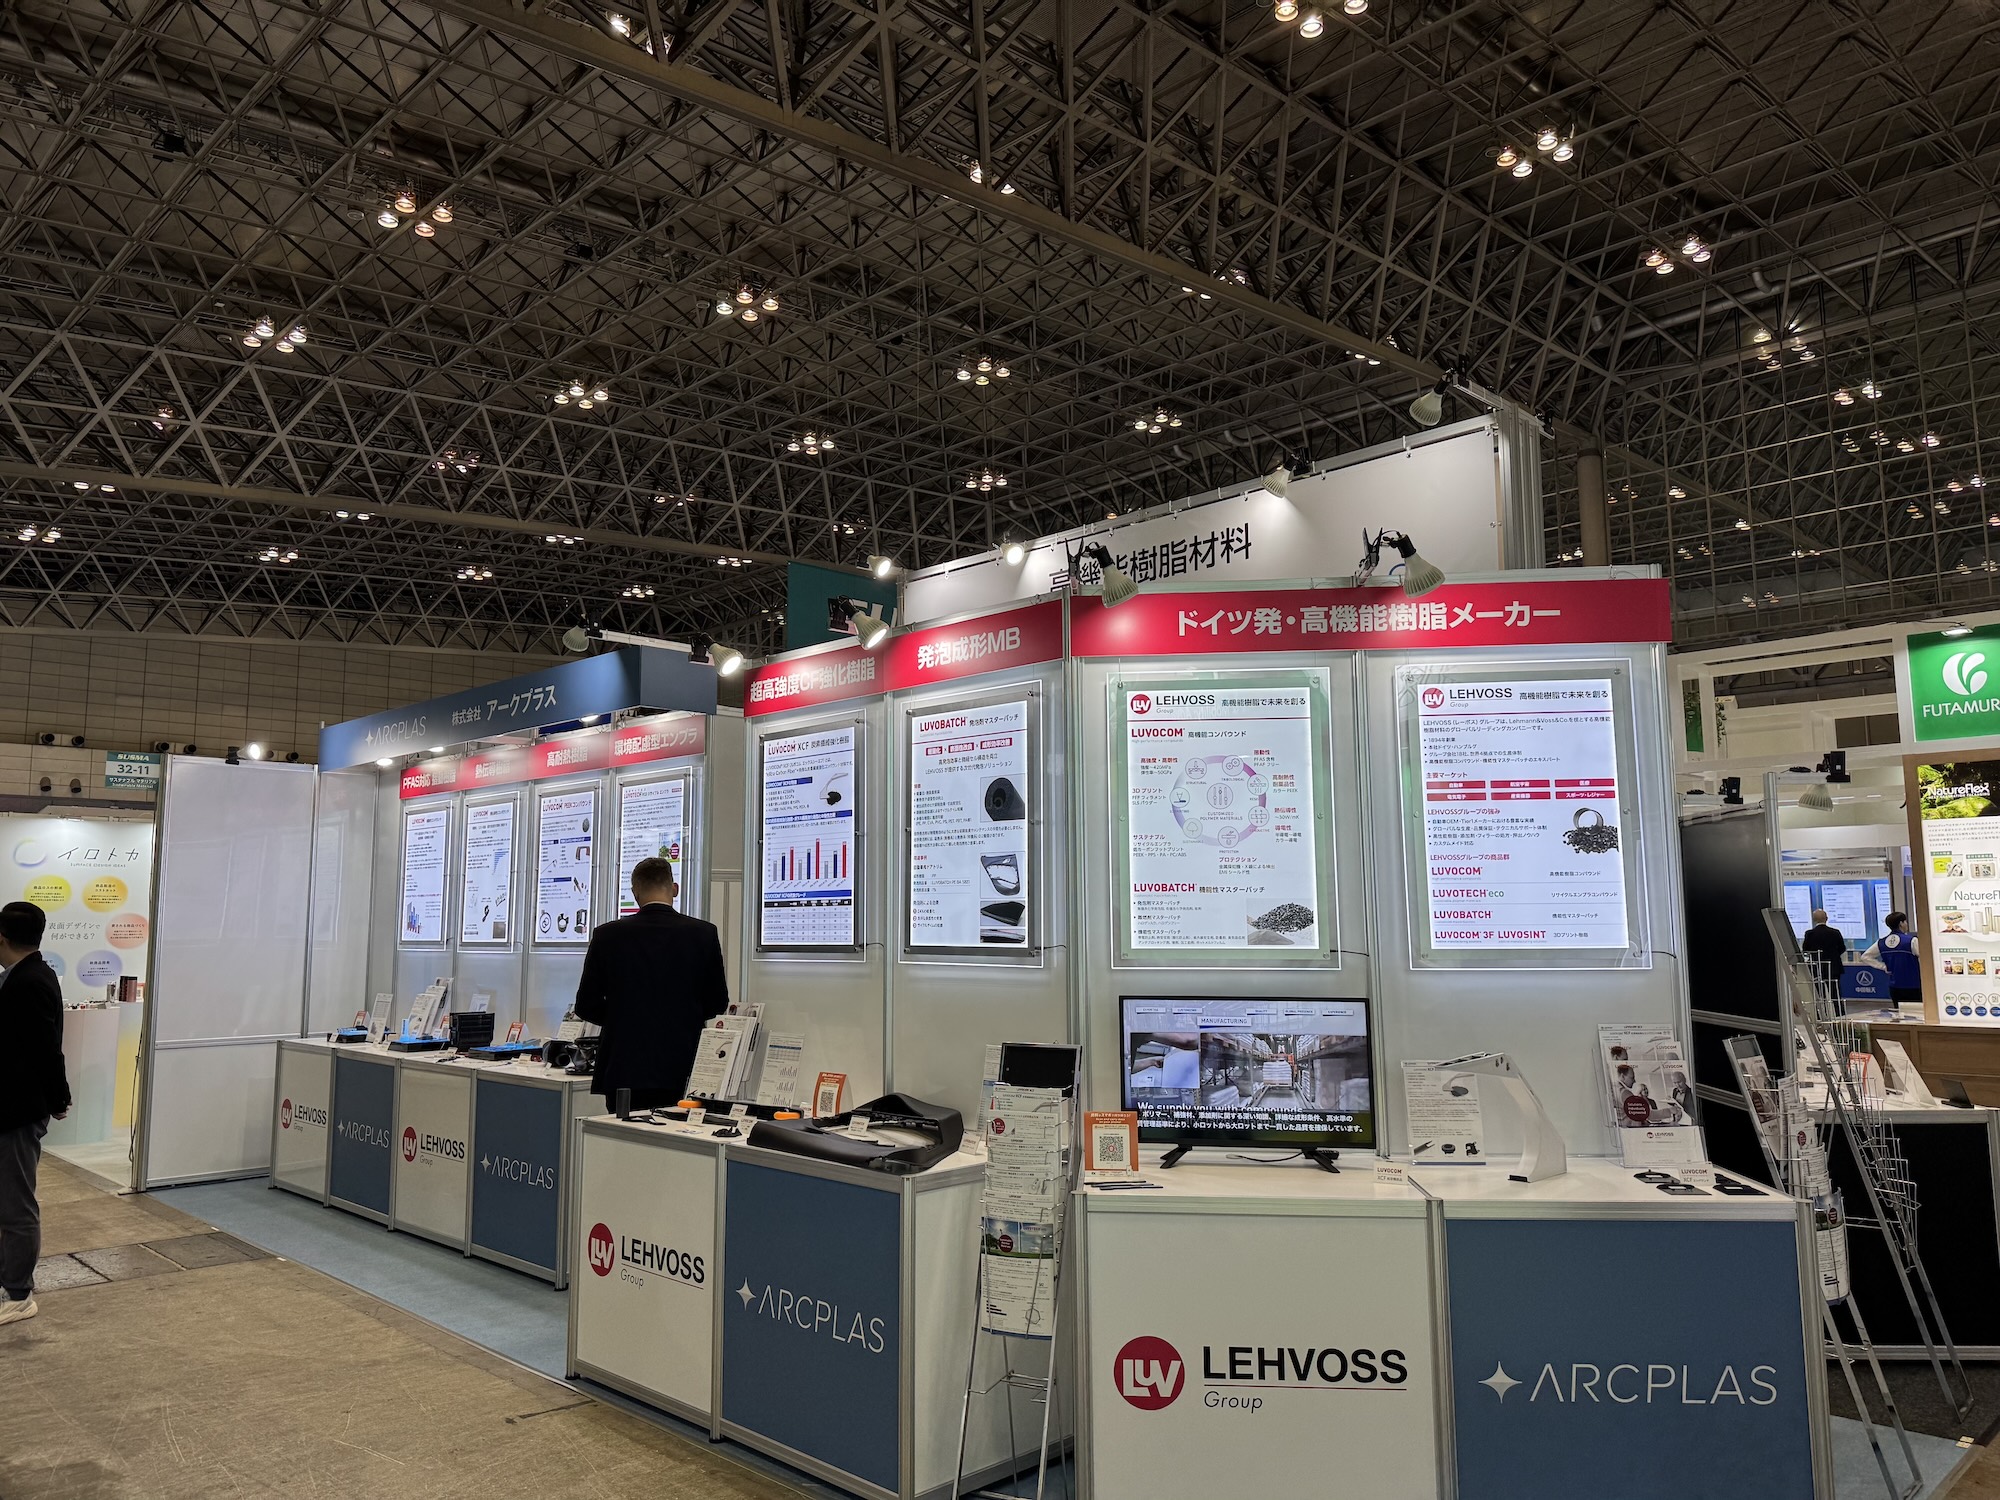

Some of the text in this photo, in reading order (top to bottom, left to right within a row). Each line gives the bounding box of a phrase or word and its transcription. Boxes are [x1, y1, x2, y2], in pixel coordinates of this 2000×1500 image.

[1178, 601, 1561, 636] ドイツ発・高機能樹脂メーカー
[917, 627, 1021, 670] 発泡成形MB
[750, 657, 876, 704] 超高強度CF強化樹脂
[1156, 694, 1215, 706] LEHVOSS
[1221, 697, 1306, 707] 高機能樹脂で未来を創る
[1450, 688, 1512, 699] LEHVOSS
[1519, 690, 1608, 700] 高機能樹脂で未来を創る
[451, 685, 557, 727] 株式会社 アークプラス
[373, 716, 426, 745] ARCPLAS
[920, 714, 1019, 732] LUVOBATCH 発泡剤マスターバッチ
[614, 727, 697, 757] 環境配慮型エンプラ
[1131, 728, 1183, 738] LUVOCOM
[546, 747, 588, 767] 高耐熱樹脂
[768, 743, 796, 755] LUVOCOM
[797, 742, 809, 751] XCF
[117, 764, 149, 774] 32-11
[1928, 783, 1990, 796] NatureFlex
[1431, 867, 1481, 875] LUVOCOM
[1134, 883, 1195, 892] LUVOBATCH
[1433, 889, 1486, 897] LUVOTECH
[1488, 890, 1504, 898] eco
[1434, 911, 1491, 919] LUVOBATCH
[49, 921, 101, 930] 表面デザインで
[1435, 931, 1480, 939] LUVOCOM
[1483, 931, 1495, 939] 3F
[1498, 930, 1546, 938] LUVOSINT
[294, 1104, 327, 1125] LEHVOSS
[293, 1122, 304, 1132] Group
[345, 1120, 390, 1149] ARCPLAS
[420, 1133, 465, 1159] LEHVOSS
[420, 1155, 433, 1167] Group
[491, 1155, 554, 1190] ARCPLAS
[621, 1235, 705, 1284] LEHVOSS
[620, 1268, 644, 1289] Group
[758, 1284, 885, 1353] ARCPLAS
[1203, 1346, 1408, 1384] LEHVOSS
[1529, 1362, 1778, 1406] ARCPLAS
[1203, 1390, 1263, 1414] Group
